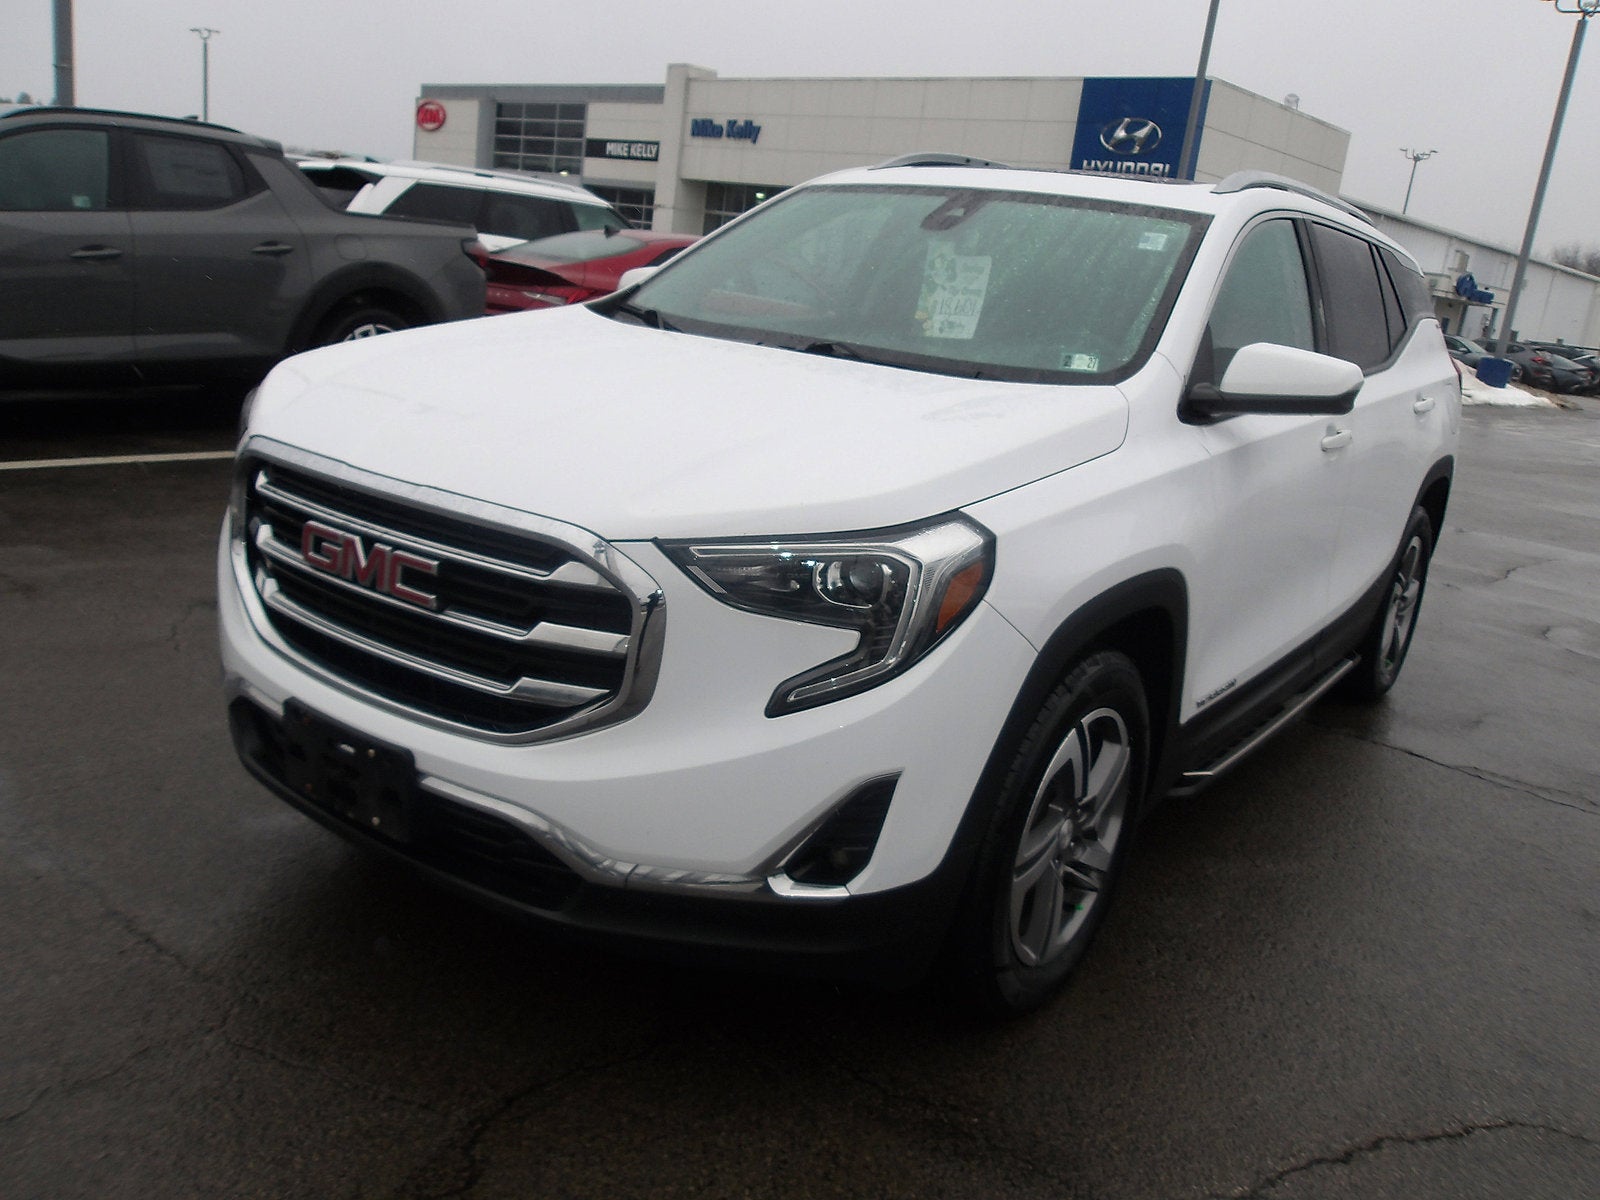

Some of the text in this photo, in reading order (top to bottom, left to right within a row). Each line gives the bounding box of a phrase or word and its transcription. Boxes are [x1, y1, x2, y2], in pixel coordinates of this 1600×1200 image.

[726, 119, 762, 144] Kelly
[606, 142, 658, 158] MIKE KELLY
[301, 520, 440, 609] GMC
